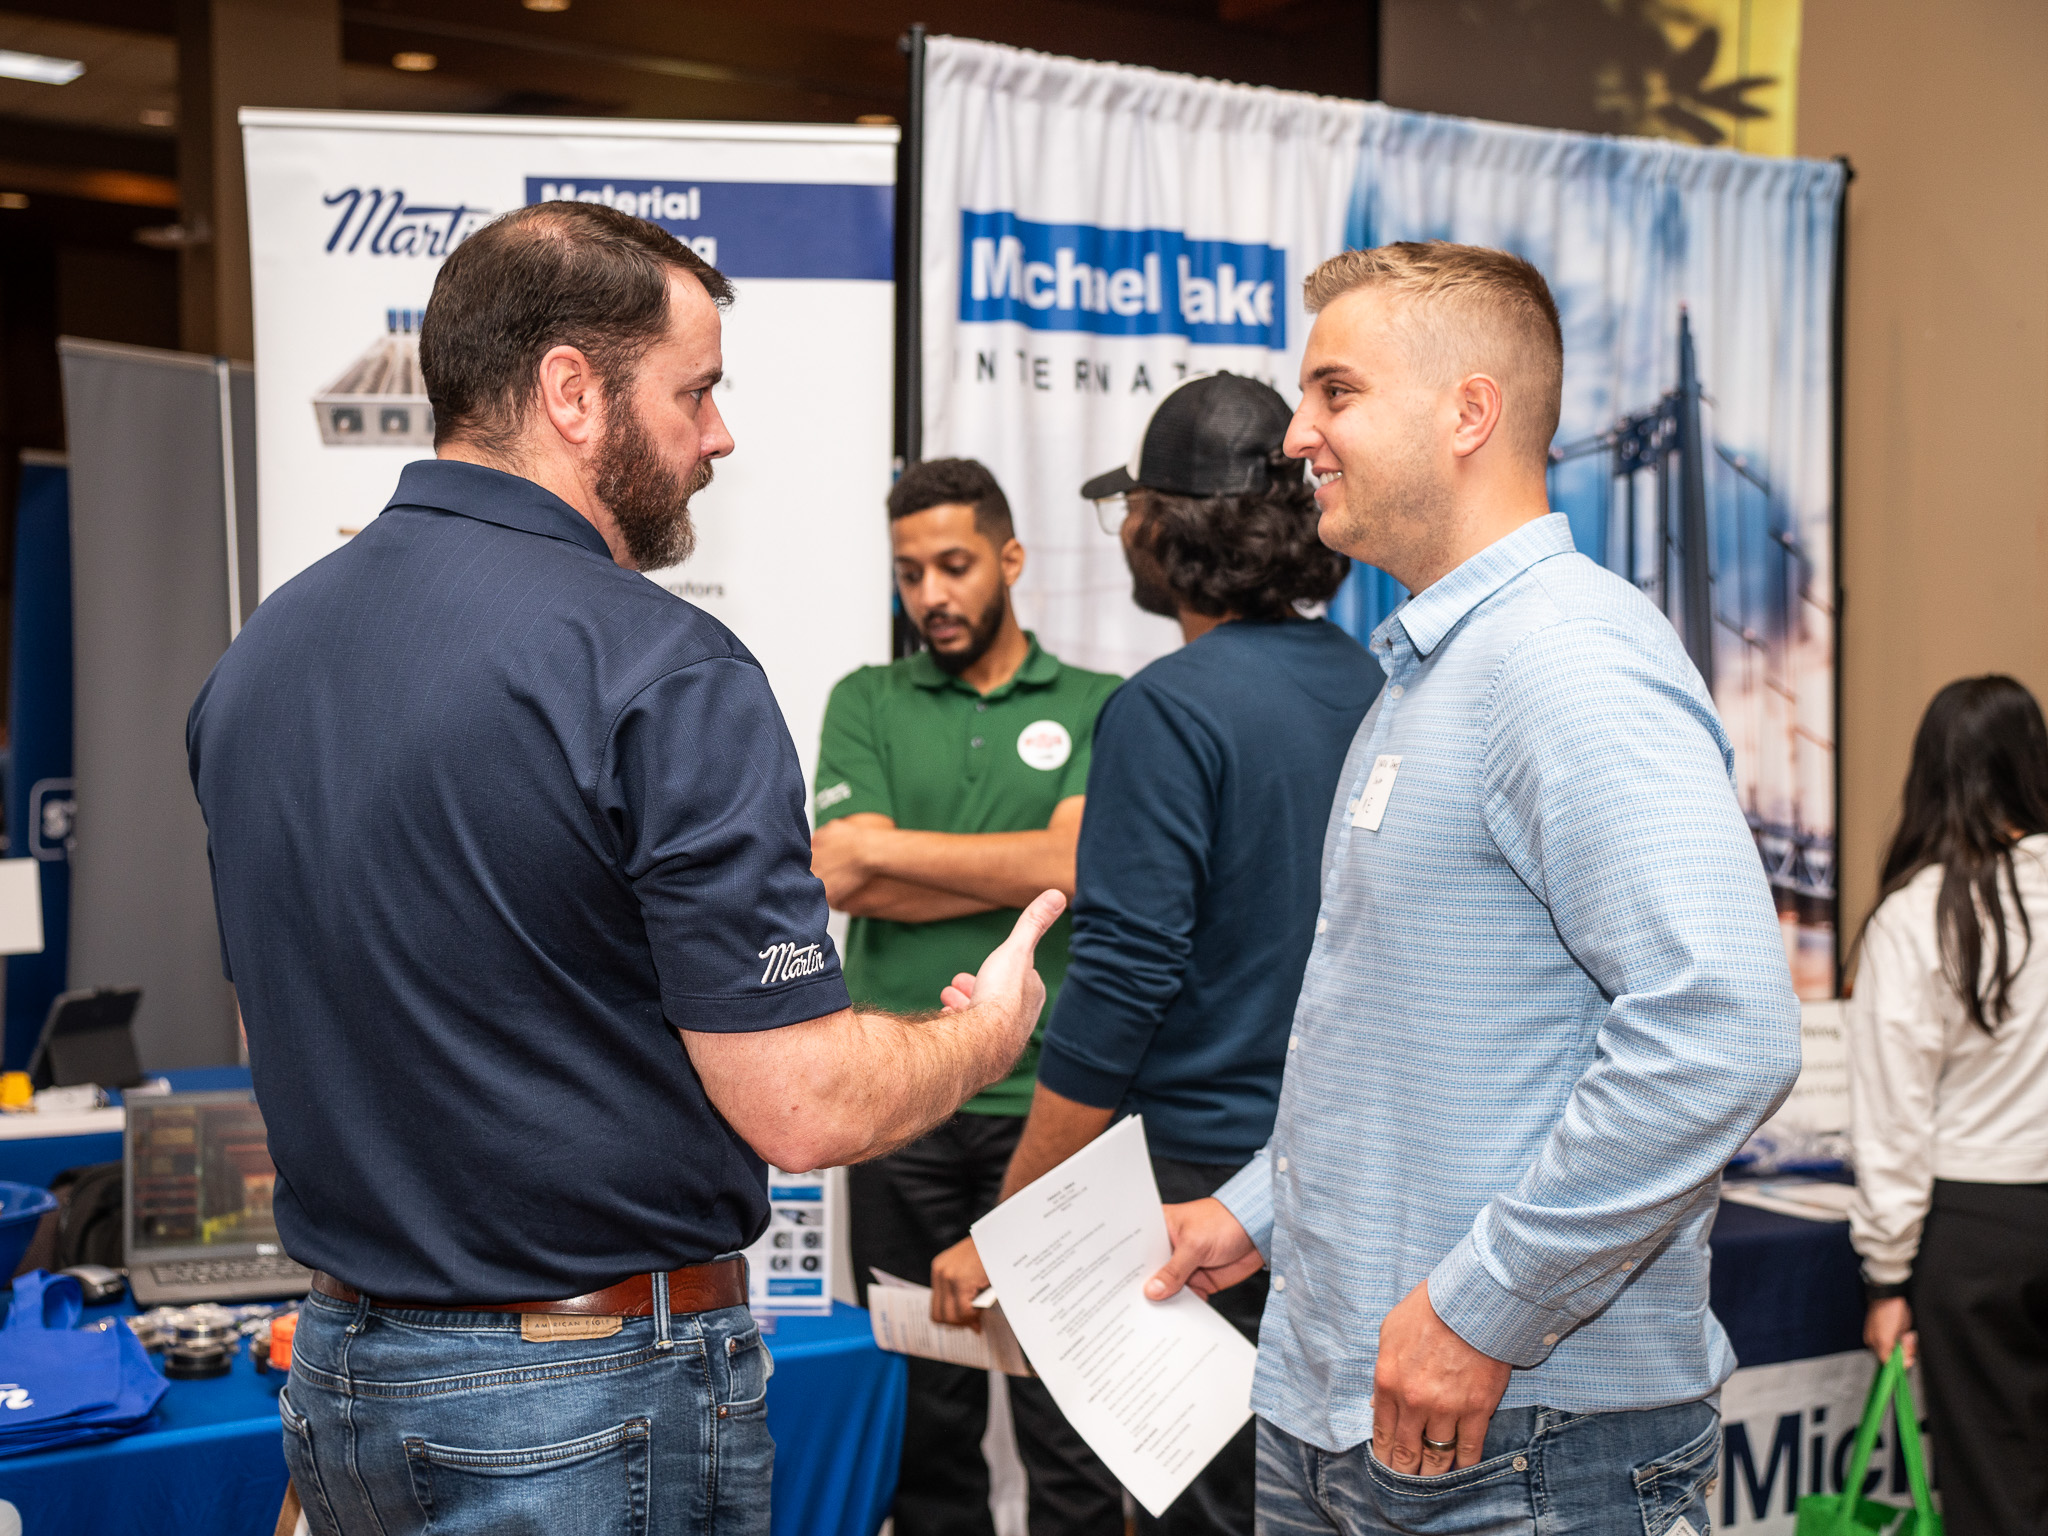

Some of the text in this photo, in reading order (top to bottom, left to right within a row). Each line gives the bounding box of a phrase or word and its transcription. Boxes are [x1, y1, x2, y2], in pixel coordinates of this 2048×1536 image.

[323, 187, 491, 257] Marti
[758, 942, 824, 984] Martin
[535, 1321, 580, 1329] AMRICAN
